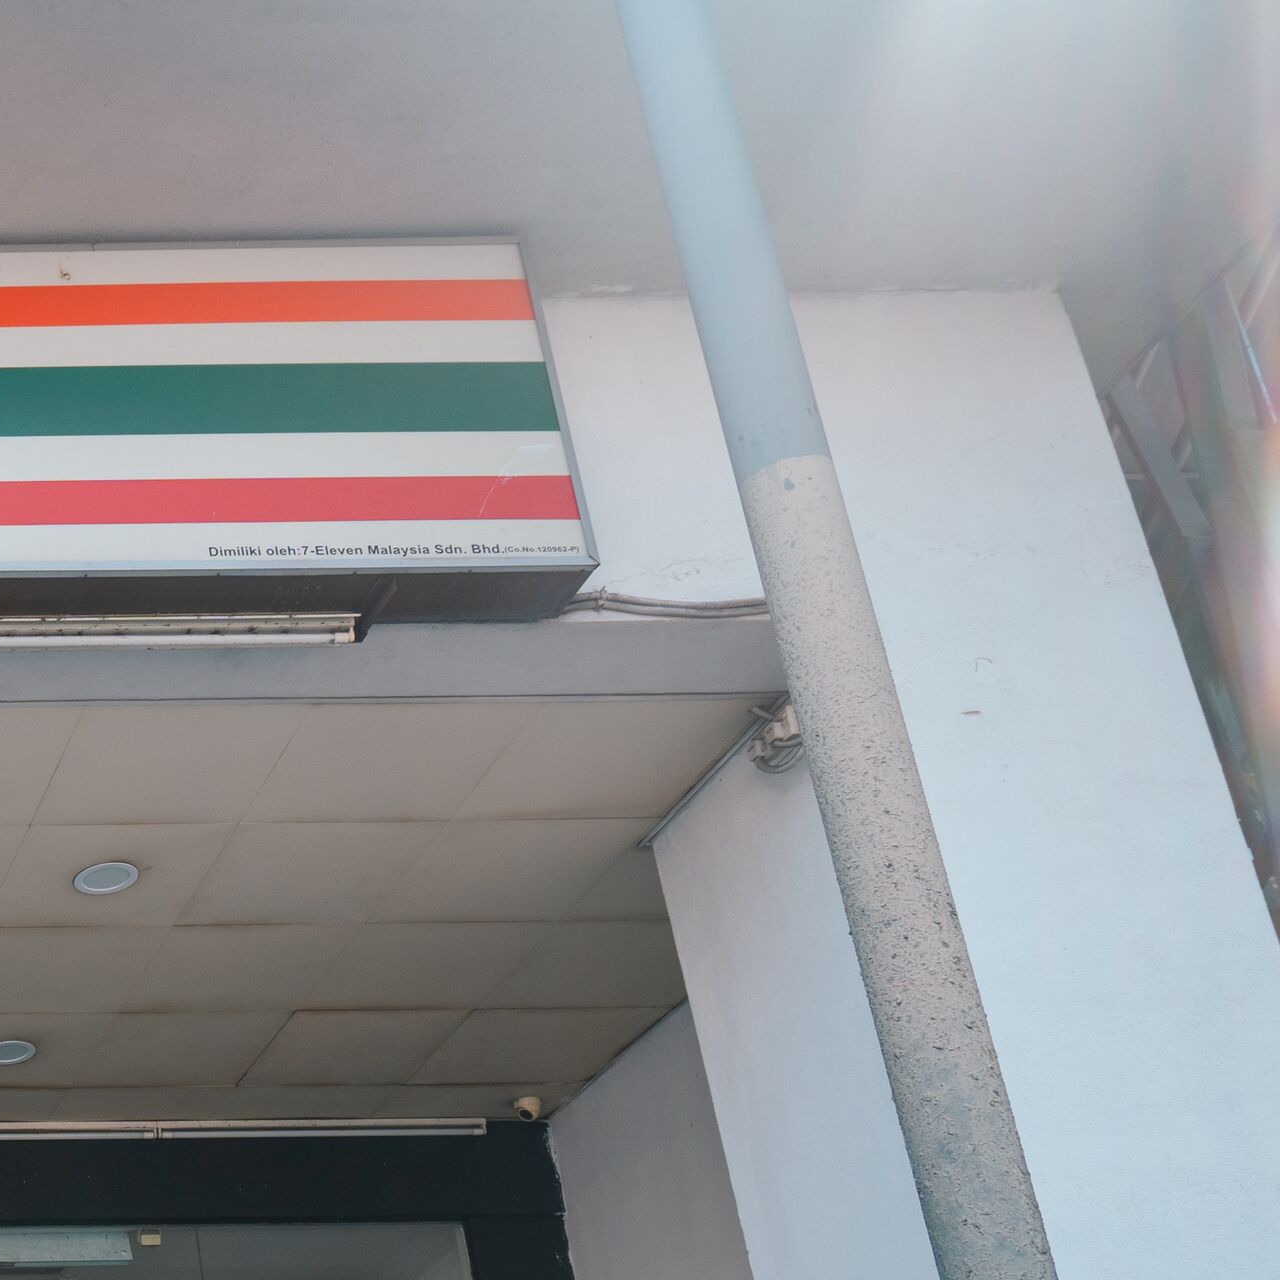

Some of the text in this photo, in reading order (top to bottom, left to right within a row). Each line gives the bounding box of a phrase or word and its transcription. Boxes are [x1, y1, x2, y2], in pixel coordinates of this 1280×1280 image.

[208, 546, 262, 557] Dimiliki
[367, 544, 430, 557] Malaysia
[434, 544, 467, 555] Sdn.
